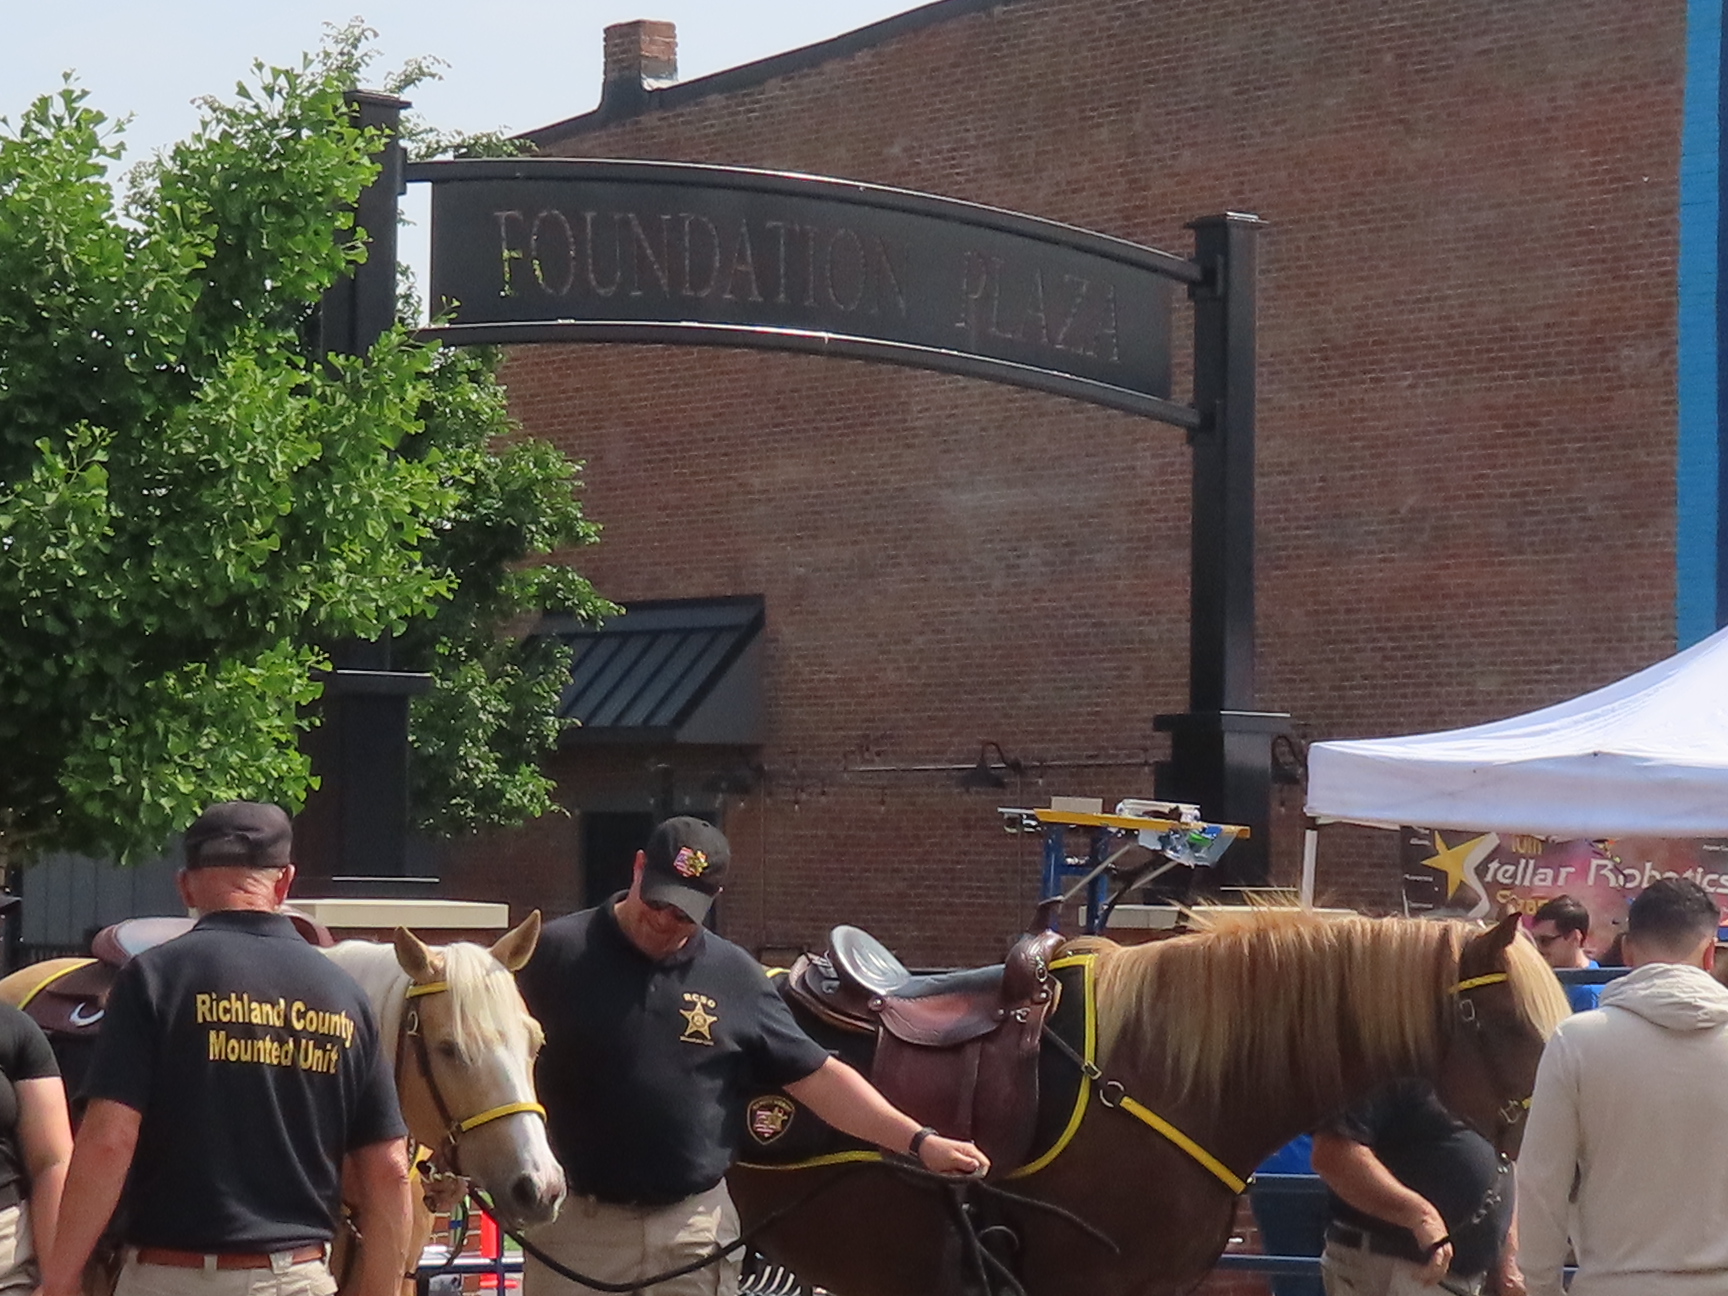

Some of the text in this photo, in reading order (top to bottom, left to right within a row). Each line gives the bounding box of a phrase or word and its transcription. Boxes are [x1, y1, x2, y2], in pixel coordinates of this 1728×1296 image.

[494, 209, 1121, 364] FOUNDATION PLAZA
[195, 991, 356, 1049] Richland County
[683, 992, 717, 1009] RCSO
[209, 1029, 341, 1075] Mounted Unit
